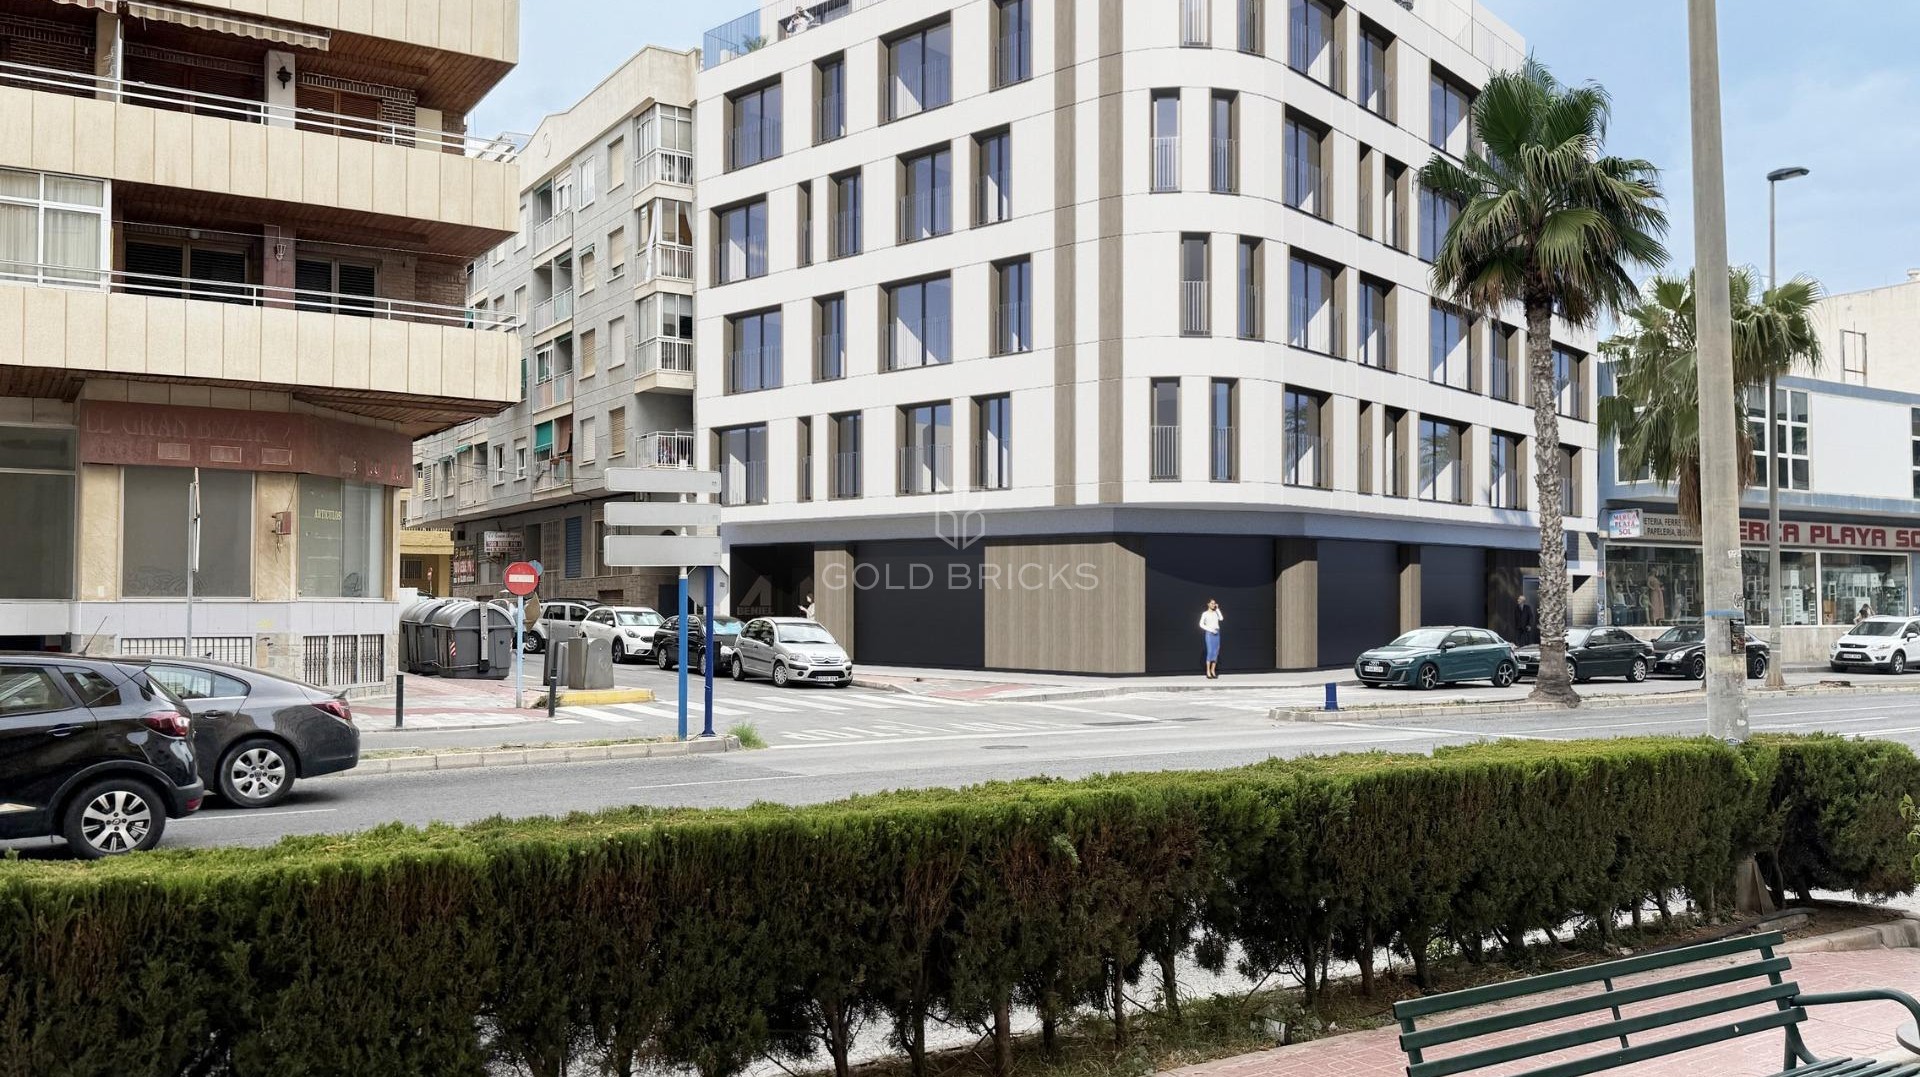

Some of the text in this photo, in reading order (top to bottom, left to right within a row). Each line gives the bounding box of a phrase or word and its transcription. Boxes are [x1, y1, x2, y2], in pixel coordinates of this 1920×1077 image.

[1613, 512, 1637, 520] MERCA
[1614, 520, 1636, 528] PLAYA
[1618, 528, 1632, 536] SOL
[1809, 524, 1887, 548] PLAYA
